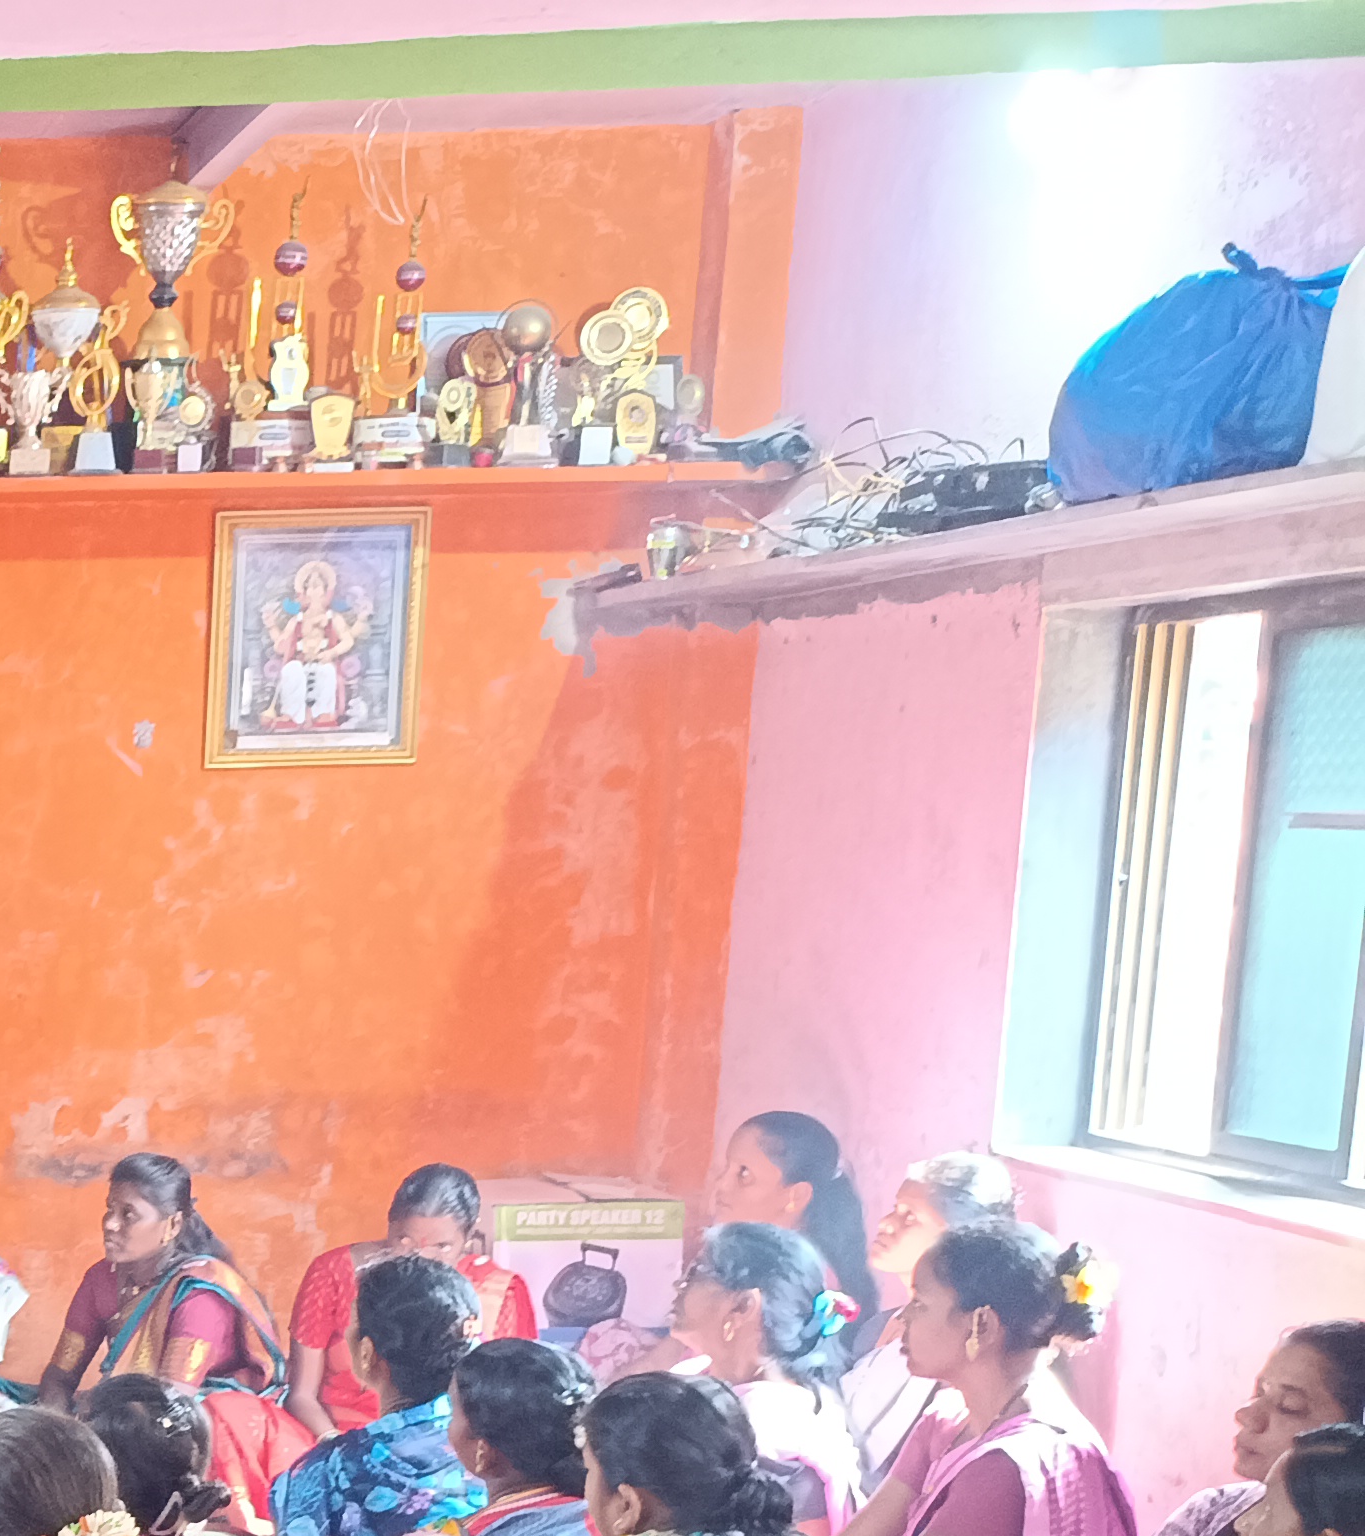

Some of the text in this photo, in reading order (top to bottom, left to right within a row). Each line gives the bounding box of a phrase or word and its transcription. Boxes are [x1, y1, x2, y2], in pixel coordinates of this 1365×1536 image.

[515, 1208, 665, 1226] PARTY SPEAKER 12
